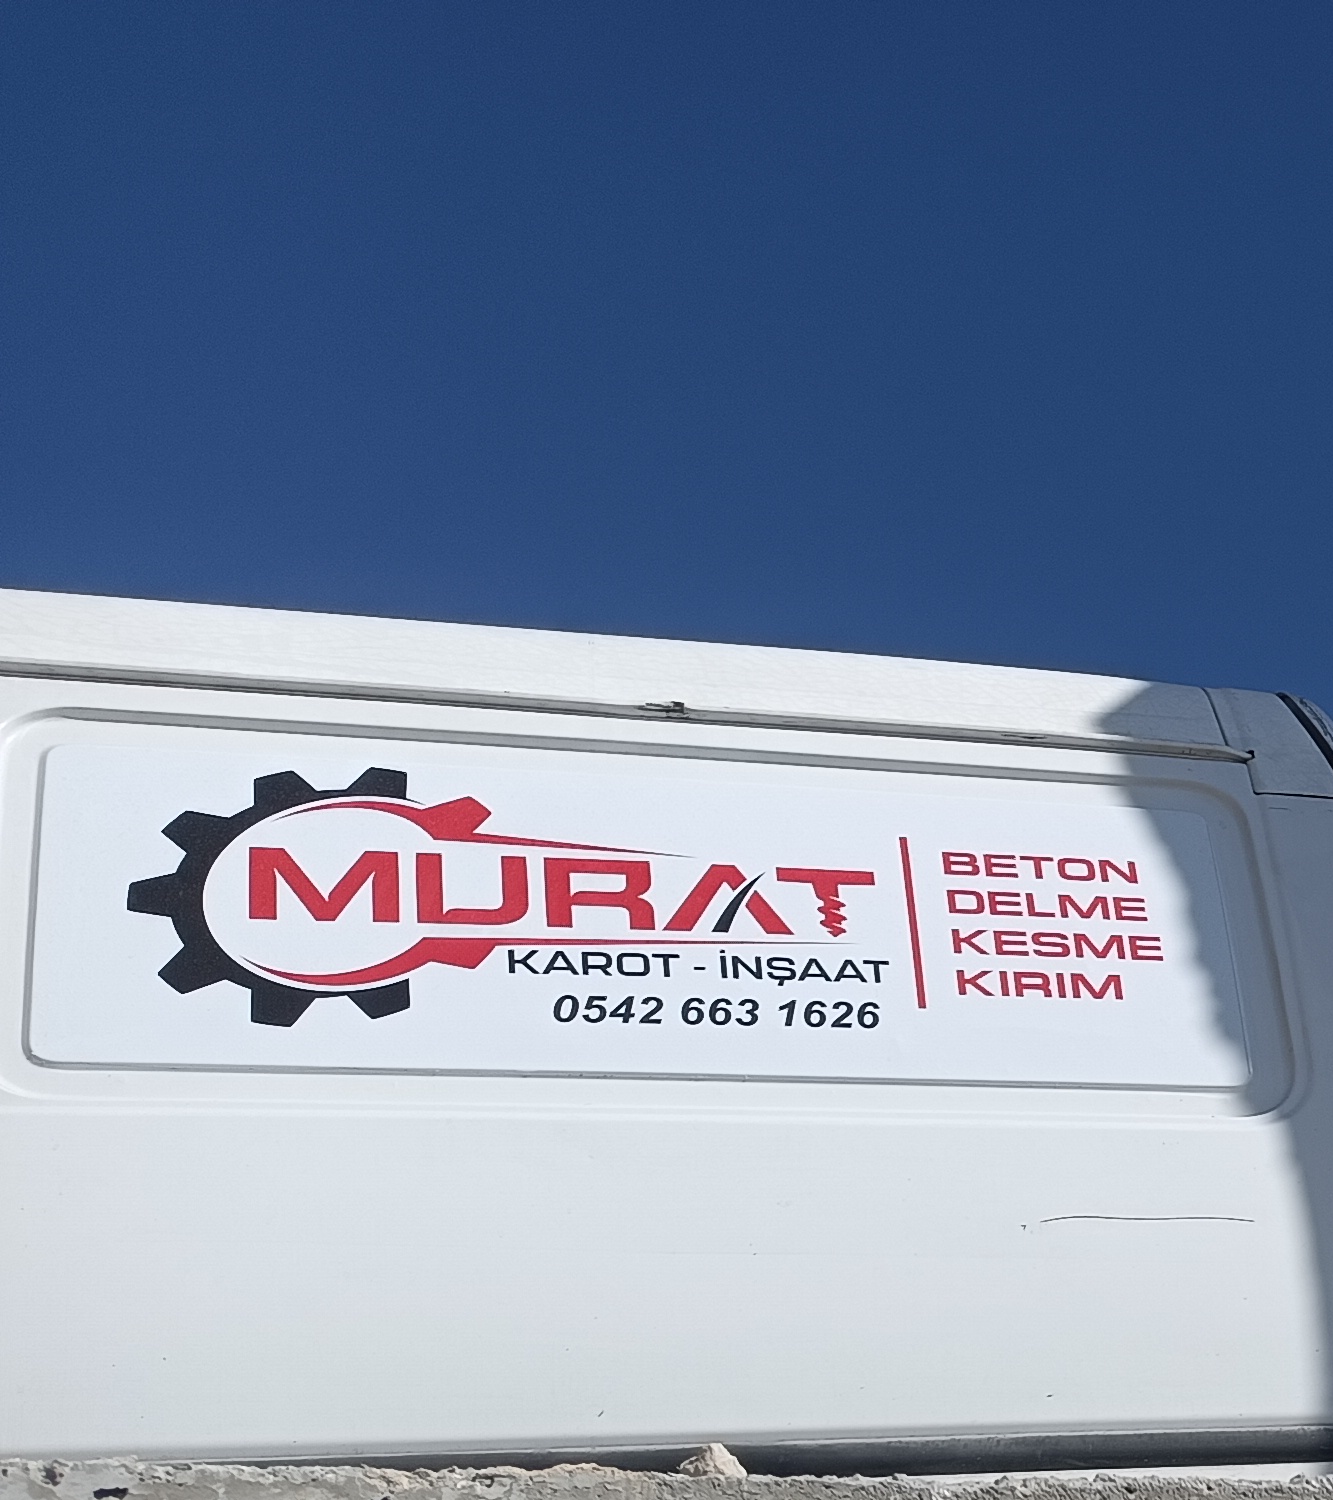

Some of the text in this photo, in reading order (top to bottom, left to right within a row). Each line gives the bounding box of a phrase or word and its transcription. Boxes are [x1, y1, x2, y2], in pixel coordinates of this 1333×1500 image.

[941, 851, 1139, 885] BETON
[248, 846, 876, 938] MURAT
[946, 889, 1149, 922] DELME
[951, 928, 1164, 962] KESME
[507, 949, 681, 978] KAROT
[719, 949, 890, 987] İNŞAAT
[955, 969, 1124, 1001] KIRIM
[553, 994, 880, 1029] 0542 663 1626
